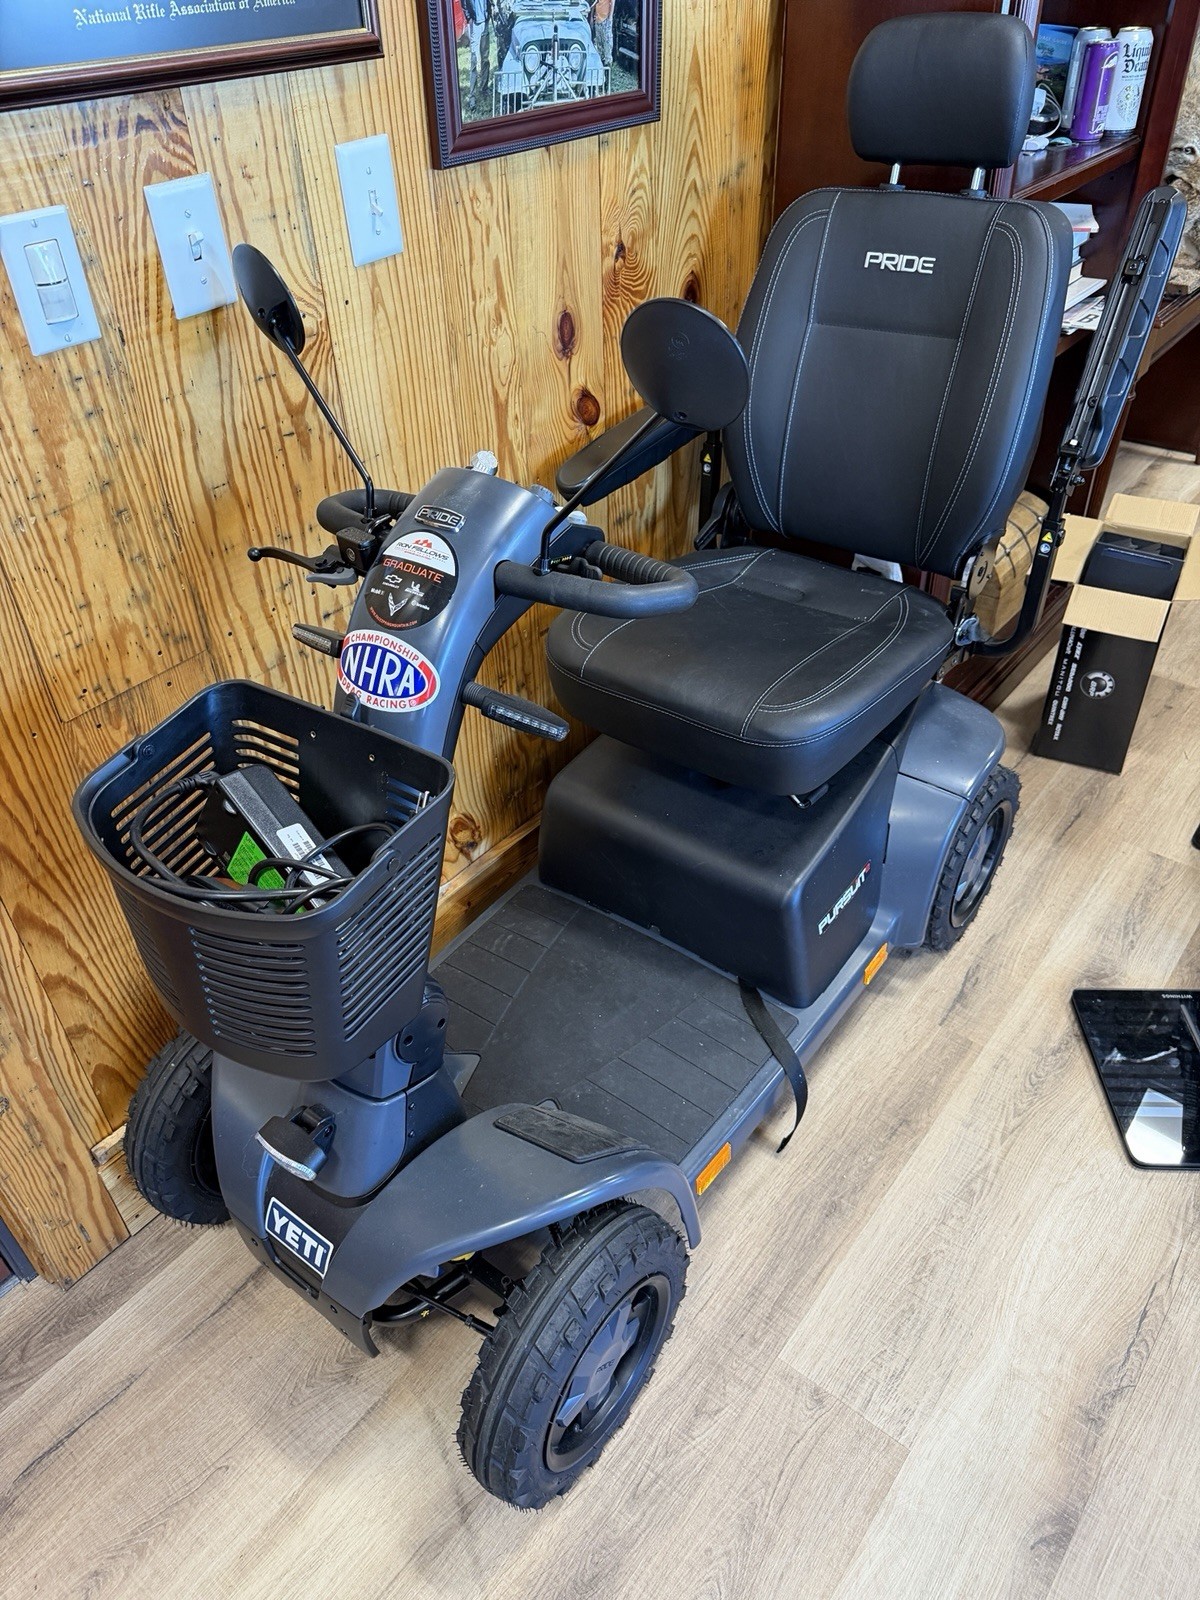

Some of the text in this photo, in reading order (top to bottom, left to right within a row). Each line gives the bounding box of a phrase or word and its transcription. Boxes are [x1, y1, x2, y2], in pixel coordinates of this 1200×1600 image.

[73, 6, 132, 30] National
[133, 3, 166, 24] Rifle
[169, 0, 236, 20] Association
[864, 251, 936, 275] PRIDE
[418, 508, 461, 526] PRIDE
[411, 545, 450, 561] FELLOWS
[383, 558, 445, 584] GRADUATE
[350, 633, 420, 662] CHAMPIONSHIP
[344, 645, 416, 697] NHRA
[1054, 658, 1069, 697] MANITOU
[341, 677, 407, 709] DRAG RACING
[818, 868, 866, 935] PURSUIT
[272, 1206, 325, 1268] YETI
